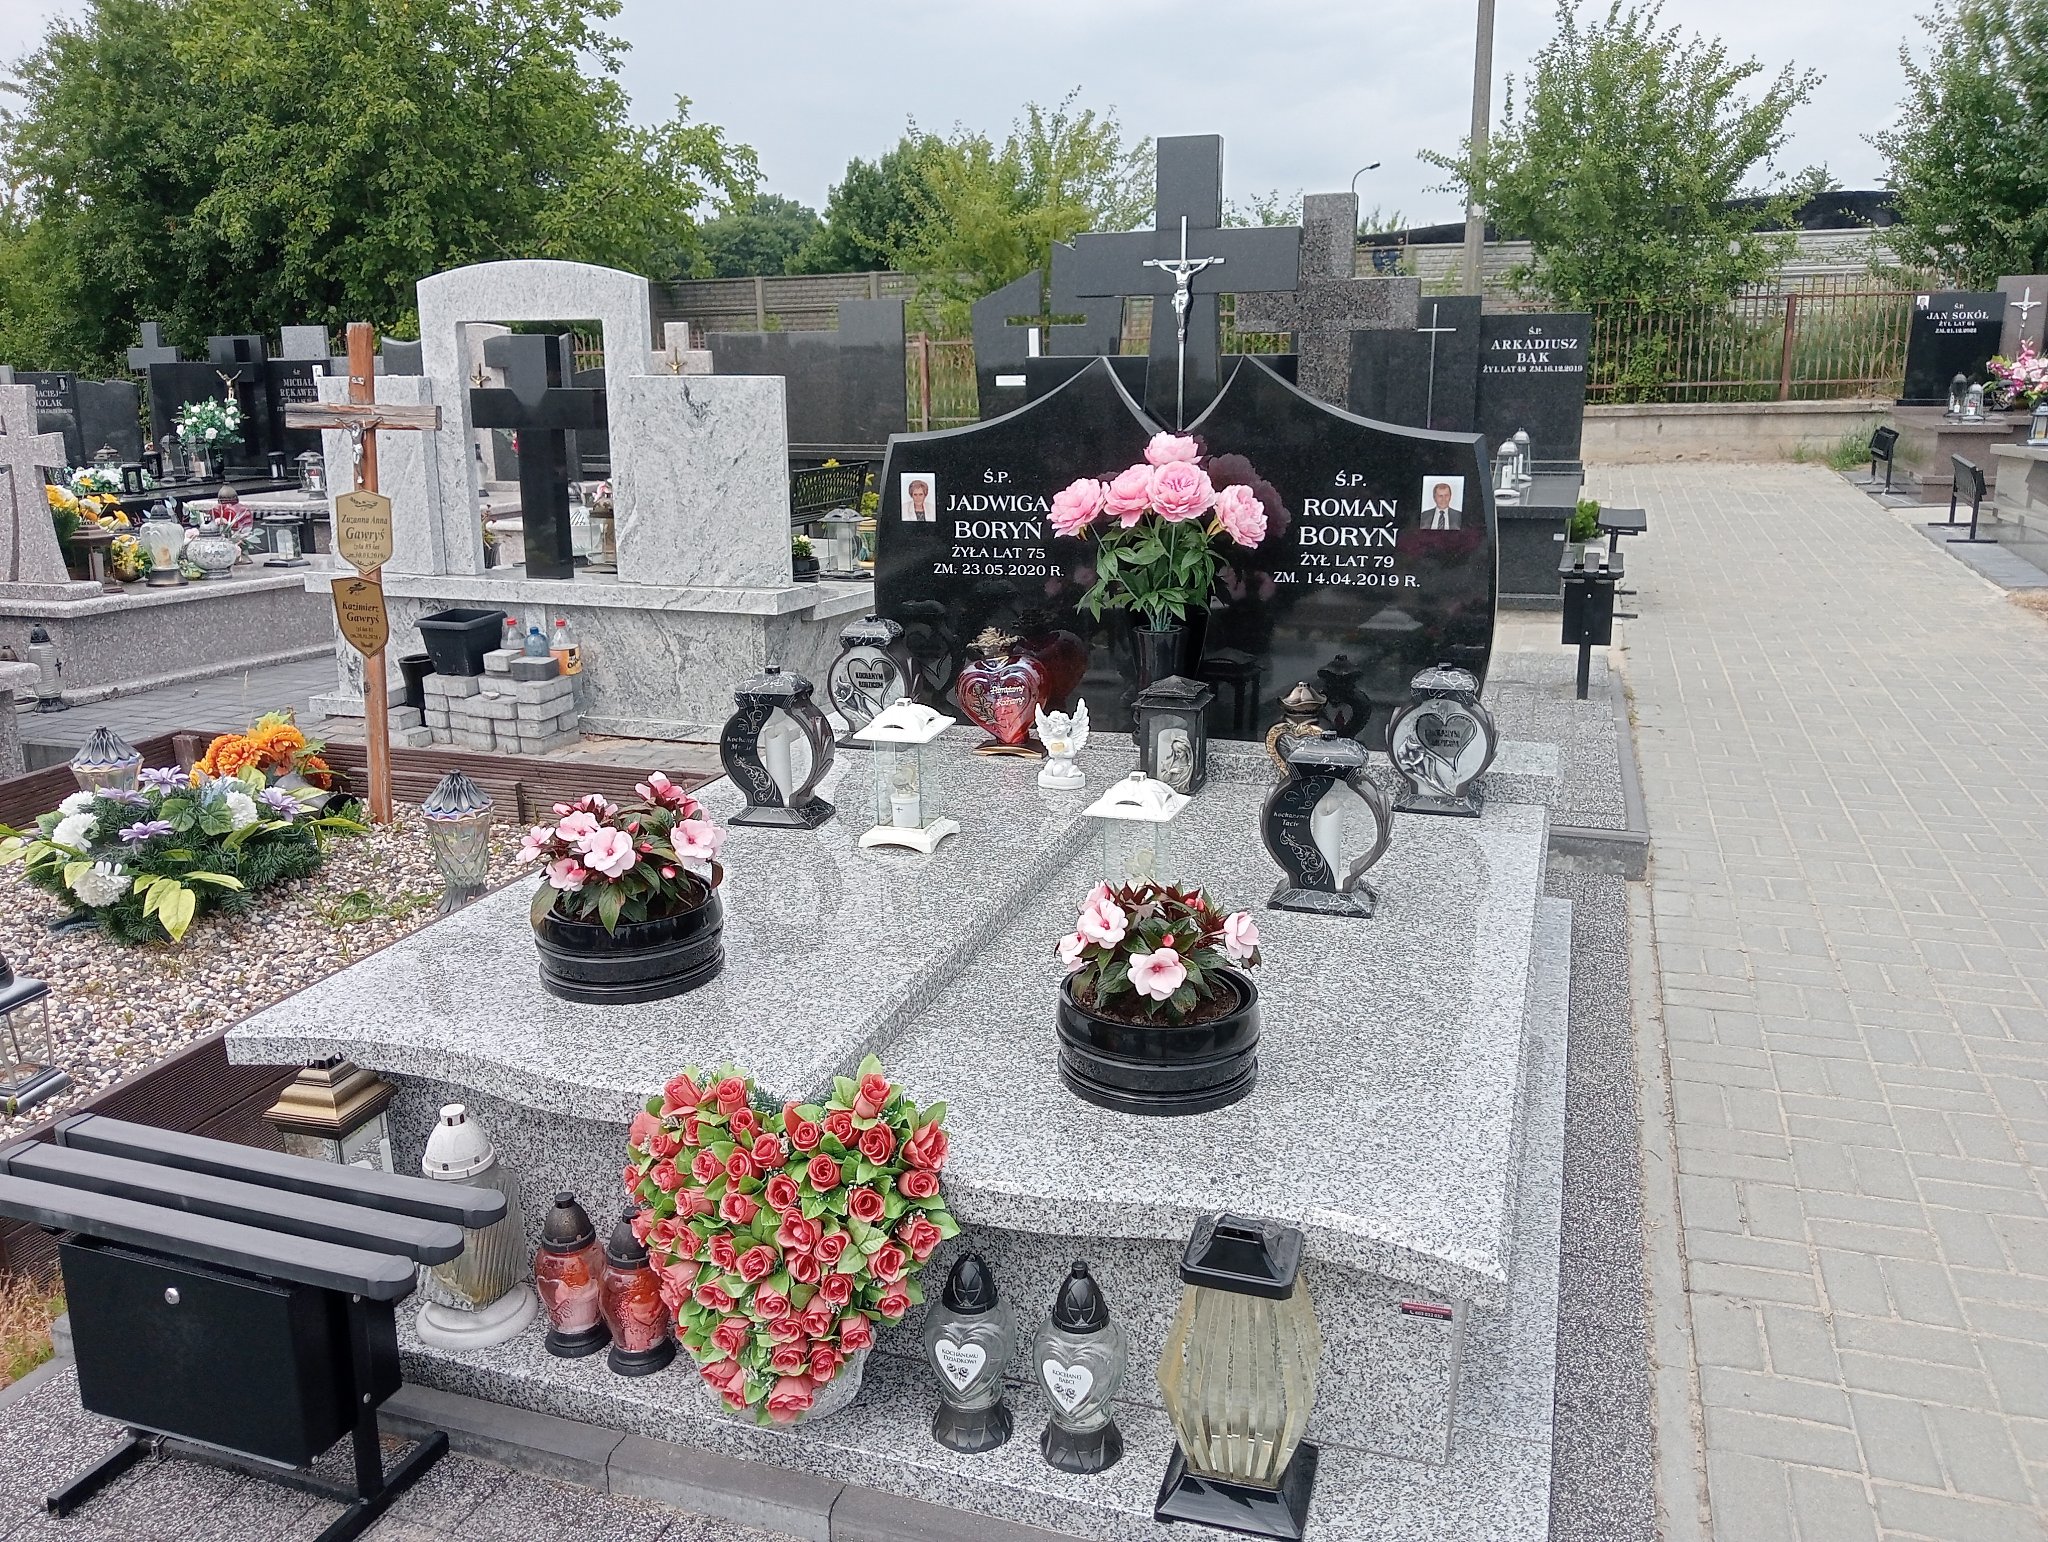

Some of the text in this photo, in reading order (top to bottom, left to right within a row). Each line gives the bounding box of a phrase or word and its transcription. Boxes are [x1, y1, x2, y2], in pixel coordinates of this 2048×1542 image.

[1926, 310, 1989, 320] JAN SOKÓŁ
[1490, 339, 1578, 350] ARKADIUSZ
[1516, 352, 1550, 365] BĄK
[1482, 365, 1500, 373] ŻYŁ
[983, 468, 1012, 484] Ś.P.
[1334, 470, 1367, 487] Ś.P.
[946, 494, 1050, 512] JADWIGA
[1303, 498, 1398, 518] ROMAN
[371, 516, 388, 524] Anna
[345, 527, 385, 544] Gawryś
[954, 517, 1042, 540] BORYŃ
[1298, 522, 1399, 548] BORYŃ
[951, 544, 1046, 559] ŻYŁA LAT 75
[1300, 552, 1395, 568] ŻYŁ LAT 79
[933, 563, 1065, 577] ZM. 23.05.2020 R.
[1273, 571, 1421, 588] ZM. 14.04.2019 R.
[342, 601, 379, 612] Kazimierz
[346, 612, 379, 625] Gawryś
